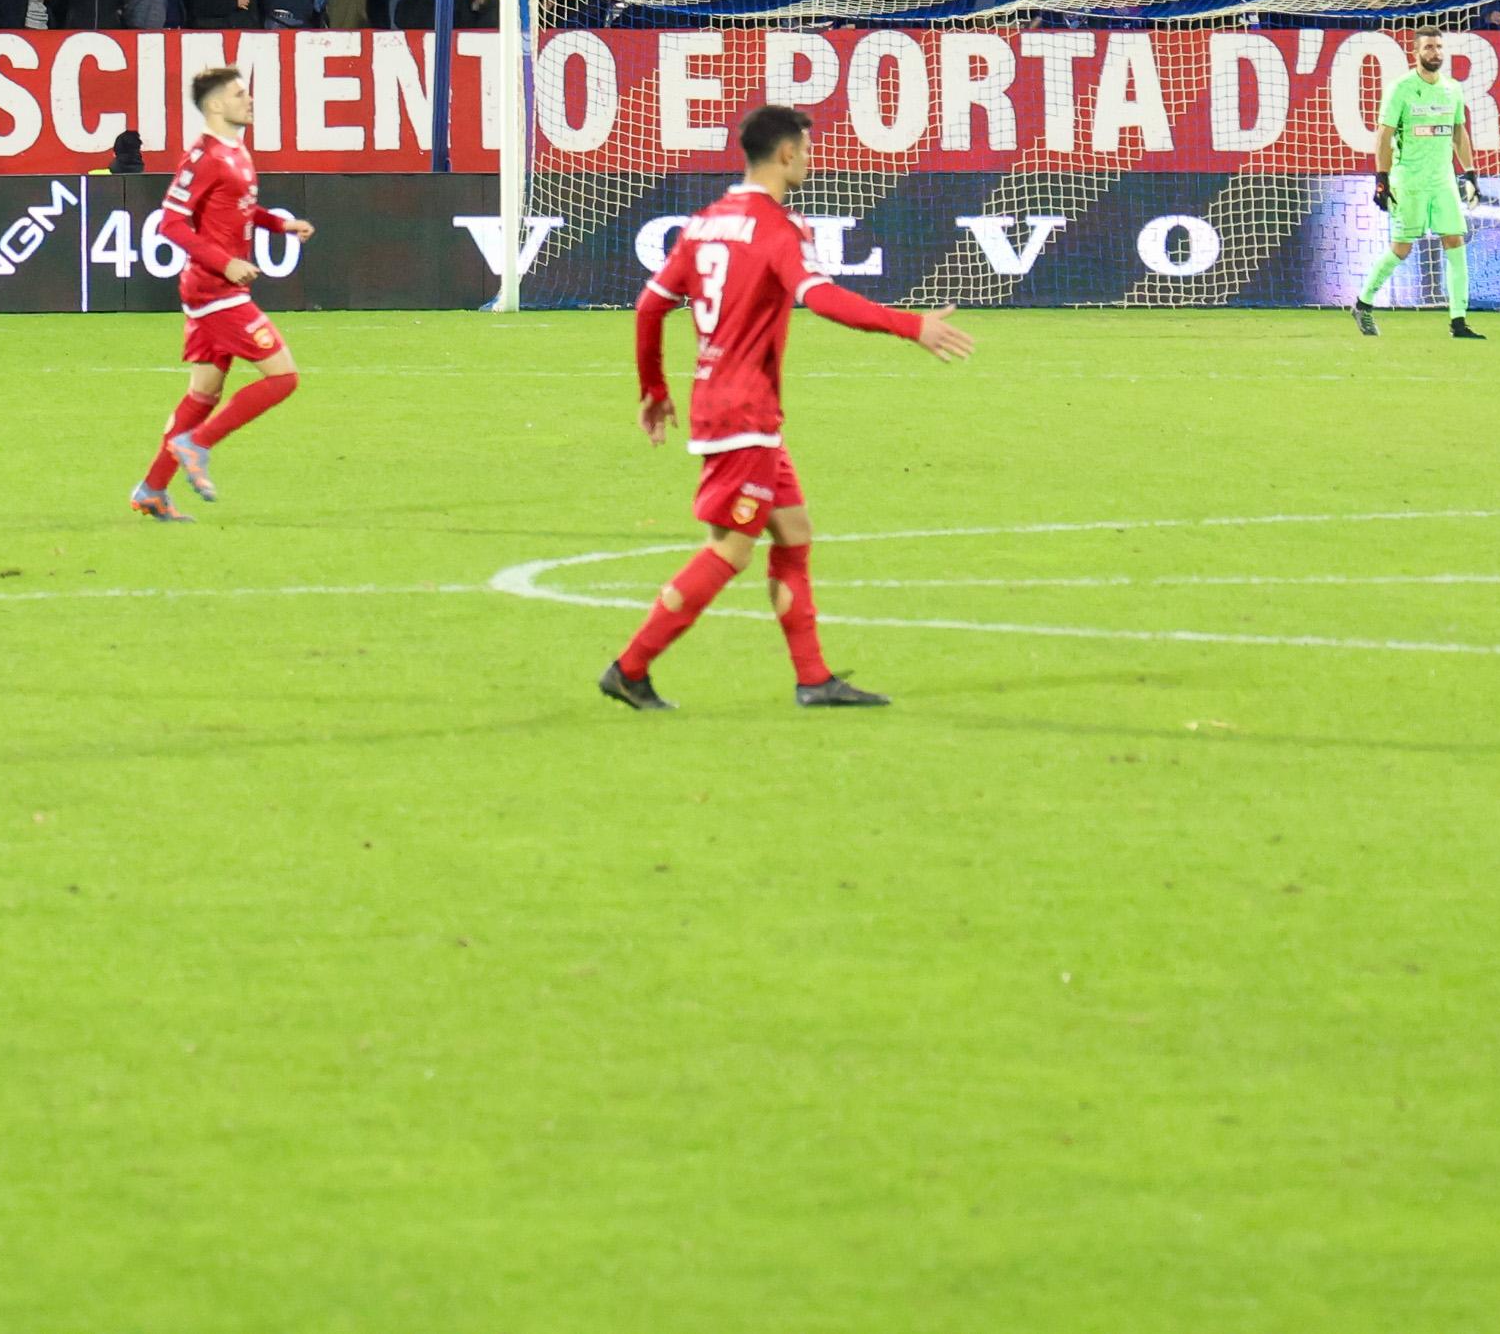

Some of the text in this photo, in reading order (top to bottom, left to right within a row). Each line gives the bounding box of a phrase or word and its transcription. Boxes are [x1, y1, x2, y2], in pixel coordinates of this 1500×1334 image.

[657, 31, 730, 151] E
[765, 30, 1167, 152] PORTA
[694, 241, 730, 334] 3
